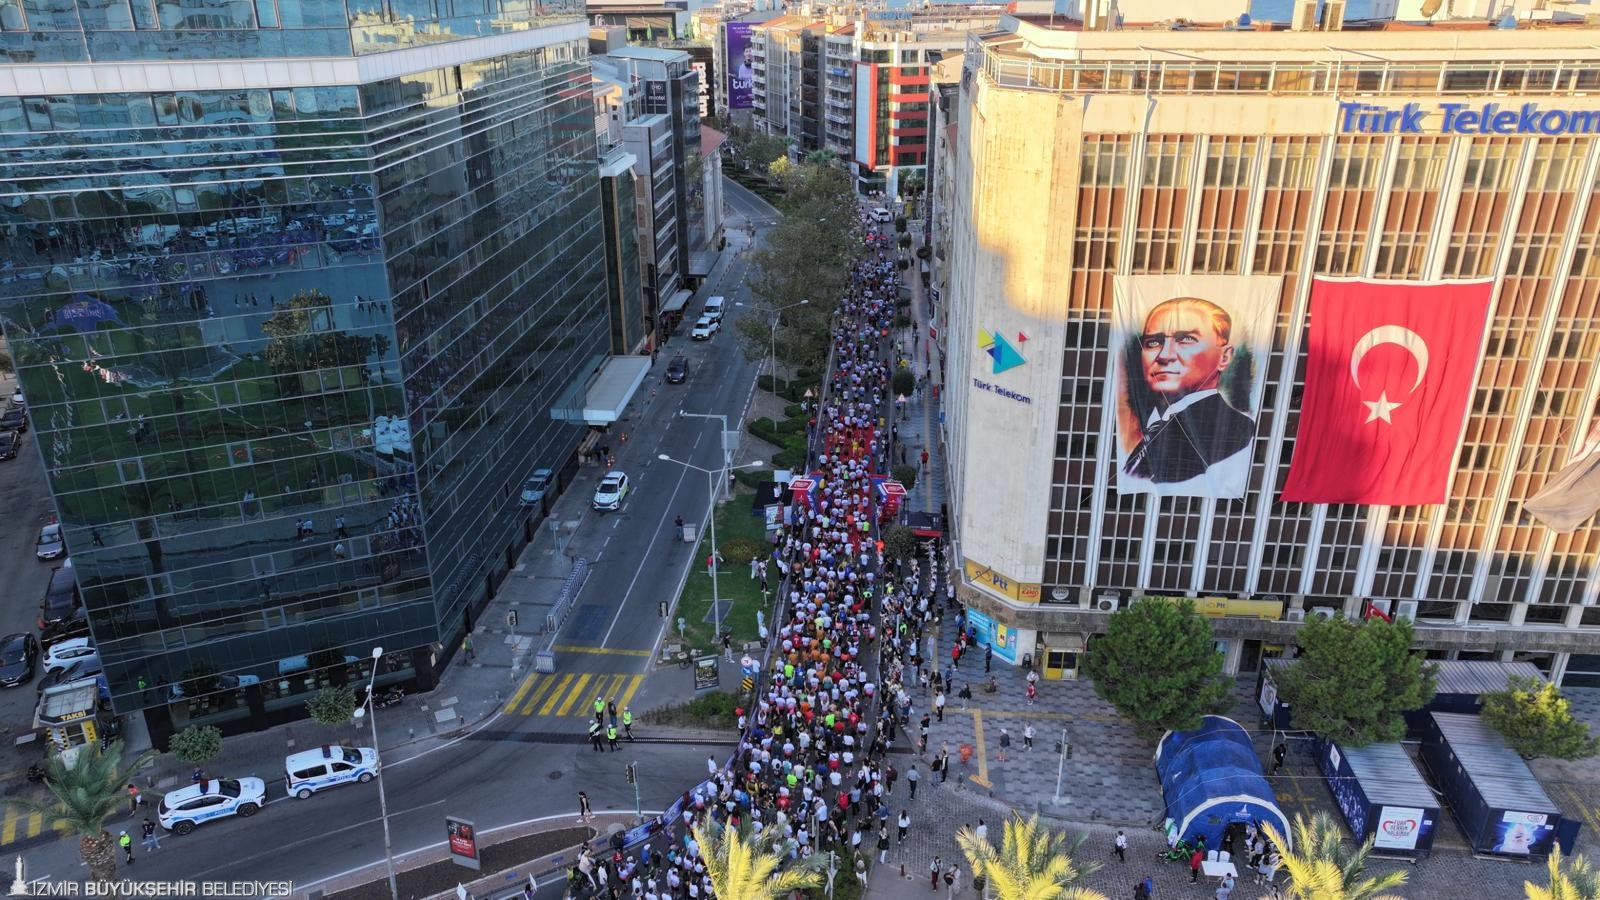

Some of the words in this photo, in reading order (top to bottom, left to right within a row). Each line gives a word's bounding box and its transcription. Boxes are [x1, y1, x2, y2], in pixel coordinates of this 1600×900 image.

[1339, 102, 1426, 134] Türk
[973, 378, 992, 391] Türk
[994, 385, 1031, 404] Telekom
[993, 574, 1009, 591] Ptt
